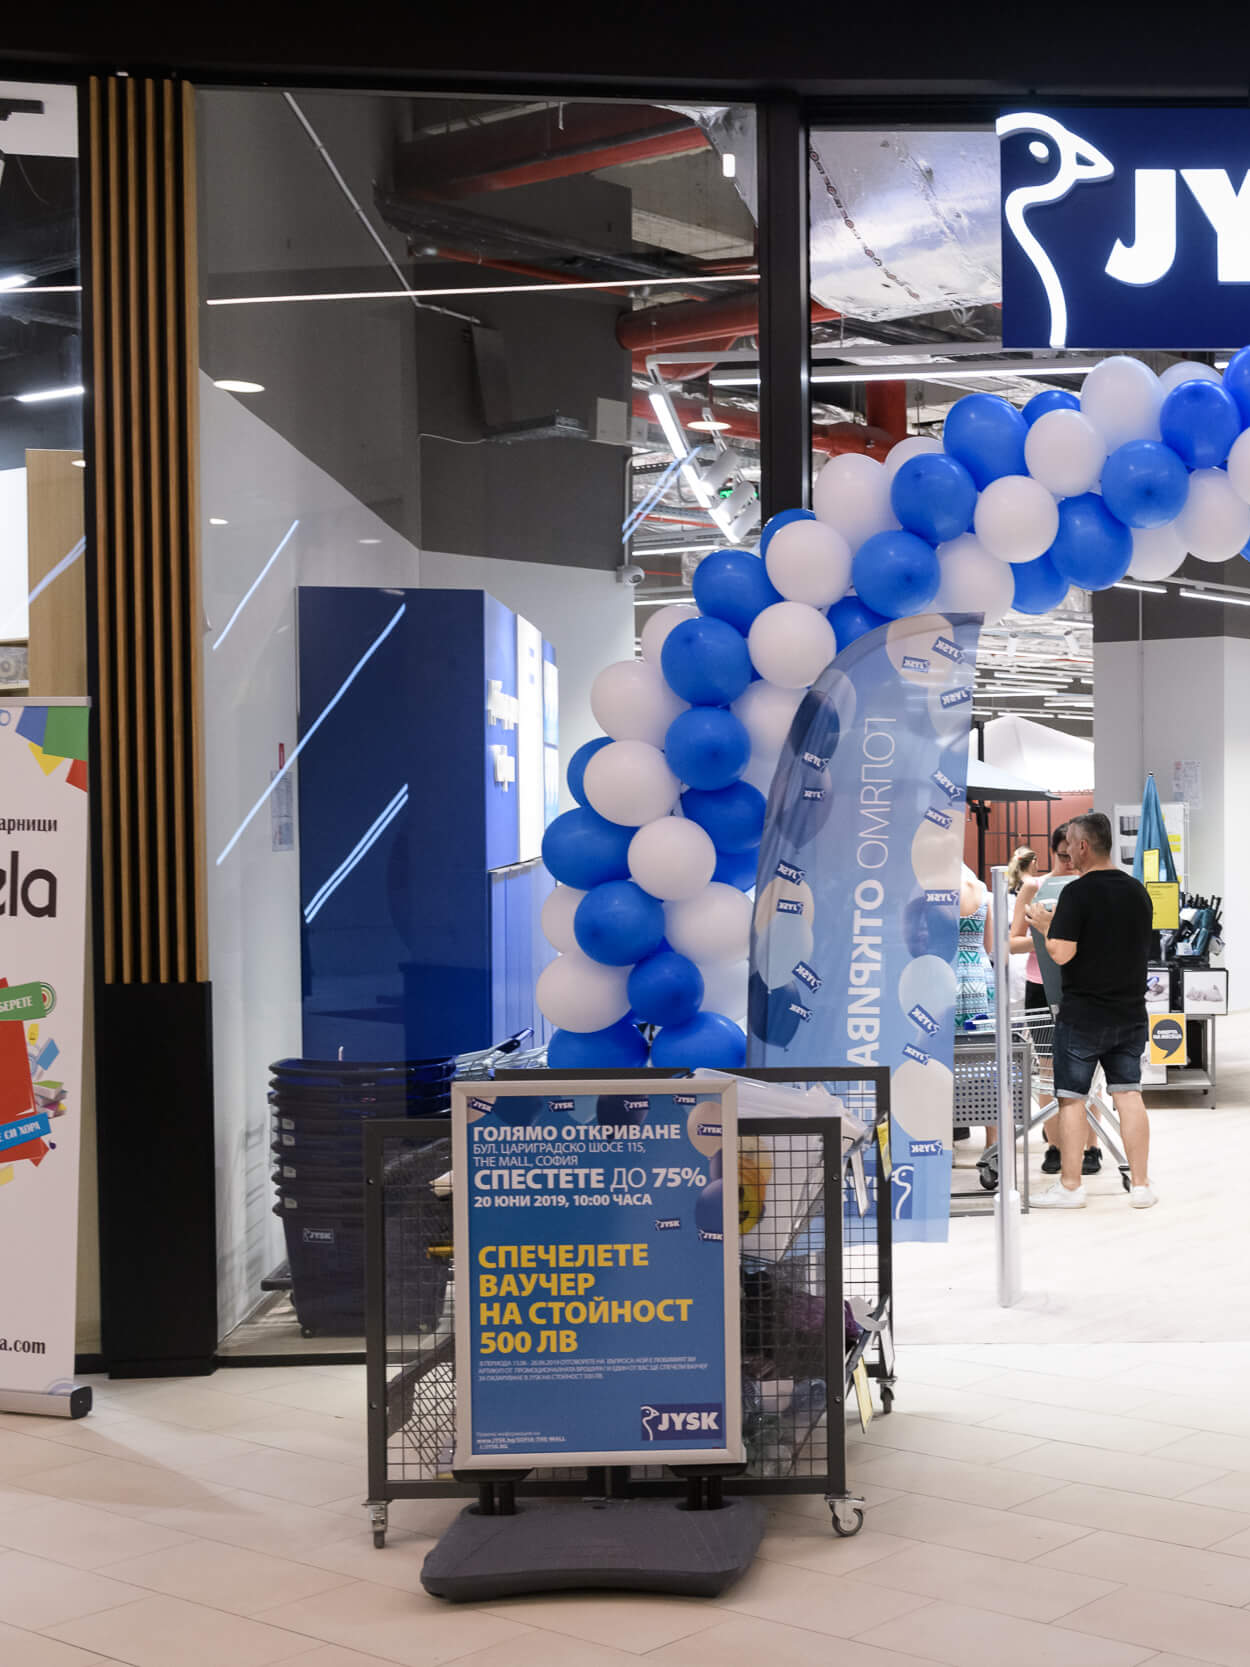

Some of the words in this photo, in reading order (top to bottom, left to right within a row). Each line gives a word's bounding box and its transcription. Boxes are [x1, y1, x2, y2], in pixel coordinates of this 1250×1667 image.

[0, 850, 58, 918] la
[473, 1126, 557, 1142] ГОЛЯМО
[562, 1124, 681, 1141] ОТКРИВАНЕ
[473, 1143, 498, 1155] БУЛ.
[501, 1142, 586, 1155] ЦАРИГРАДСКО
[589, 1142, 624, 1153] ШОСЕ
[627, 1142, 647, 1154] 115,
[473, 1157, 496, 1167] THE
[499, 1156, 533, 1168] MALL,
[535, 1155, 578, 1167] СОФИЯ
[474, 1168, 605, 1190] СПЕСТЕТЕ
[610, 1167, 647, 1192] ДО
[652, 1167, 707, 1188] 75%
[474, 1196, 491, 1208] 20
[494, 1195, 530, 1207] ЮНИ
[534, 1195, 569, 1208] 2019,
[574, 1194, 610, 1206] 10:00
[612, 1194, 653, 1206] ЧАСА
[478, 1243, 649, 1269] СПЕЧЕЛЕТЕ
[479, 1273, 595, 1297] ВАУЧЕР
[480, 1301, 522, 1325] НА
[528, 1297, 693, 1324] СТОЙНОСТ
[480, 1331, 531, 1354] 500
[536, 1329, 578, 1353] ЛВ
[657, 1412, 720, 1432] JYSK
